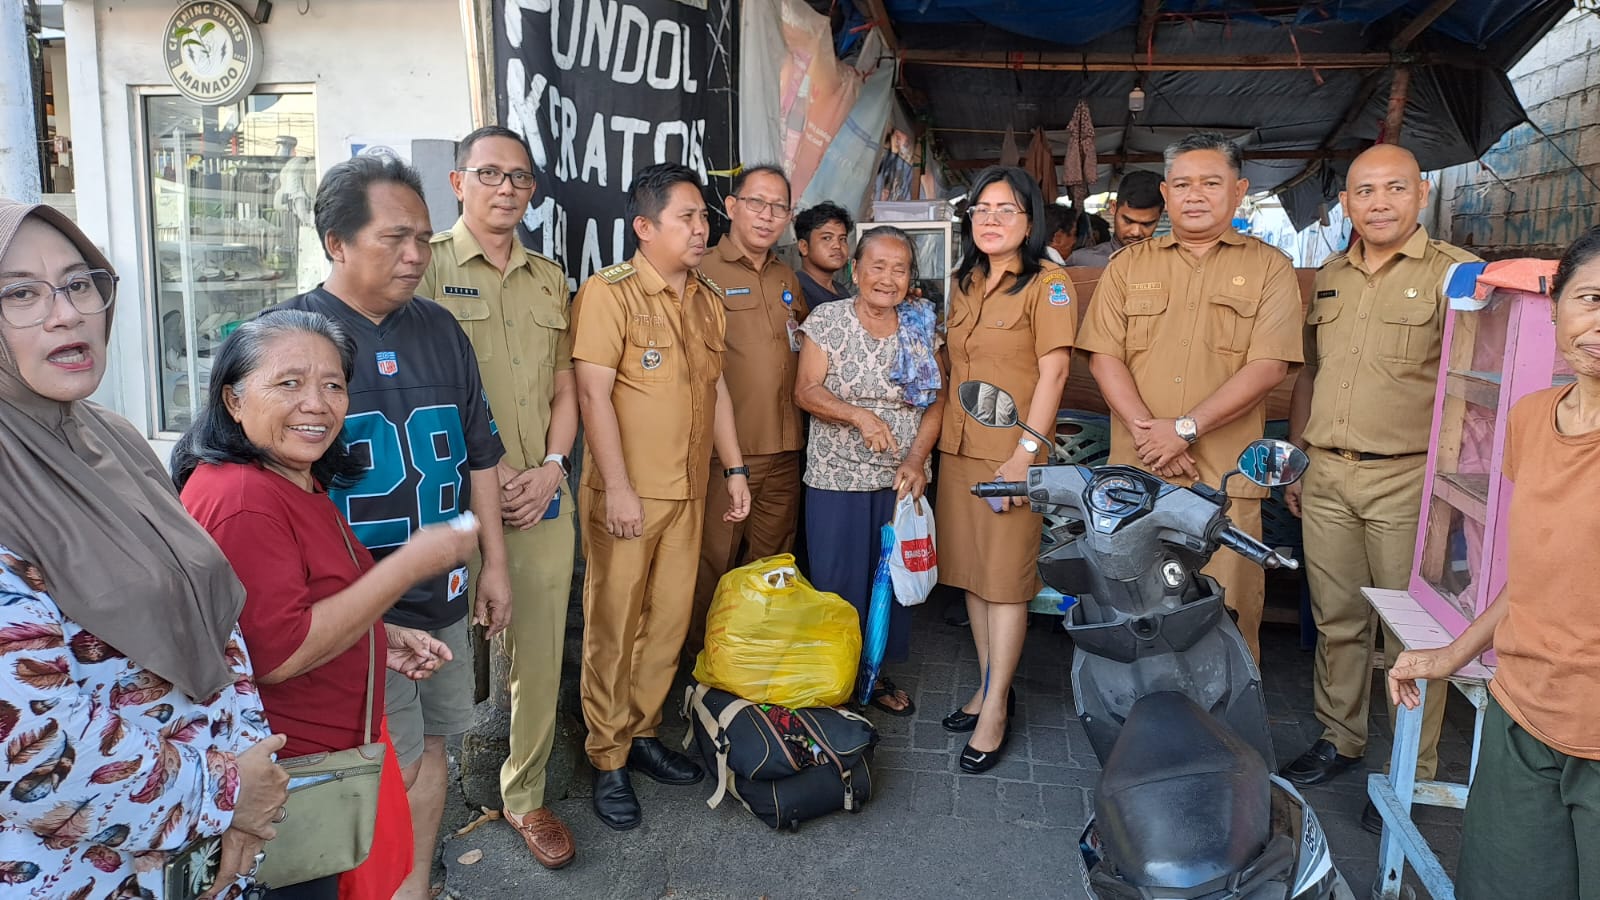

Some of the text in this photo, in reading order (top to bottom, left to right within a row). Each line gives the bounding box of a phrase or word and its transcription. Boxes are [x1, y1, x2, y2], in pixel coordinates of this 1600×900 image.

[213, 6, 244, 42] SHOES
[179, 67, 238, 94] MANADO
[328, 404, 468, 550] 28
